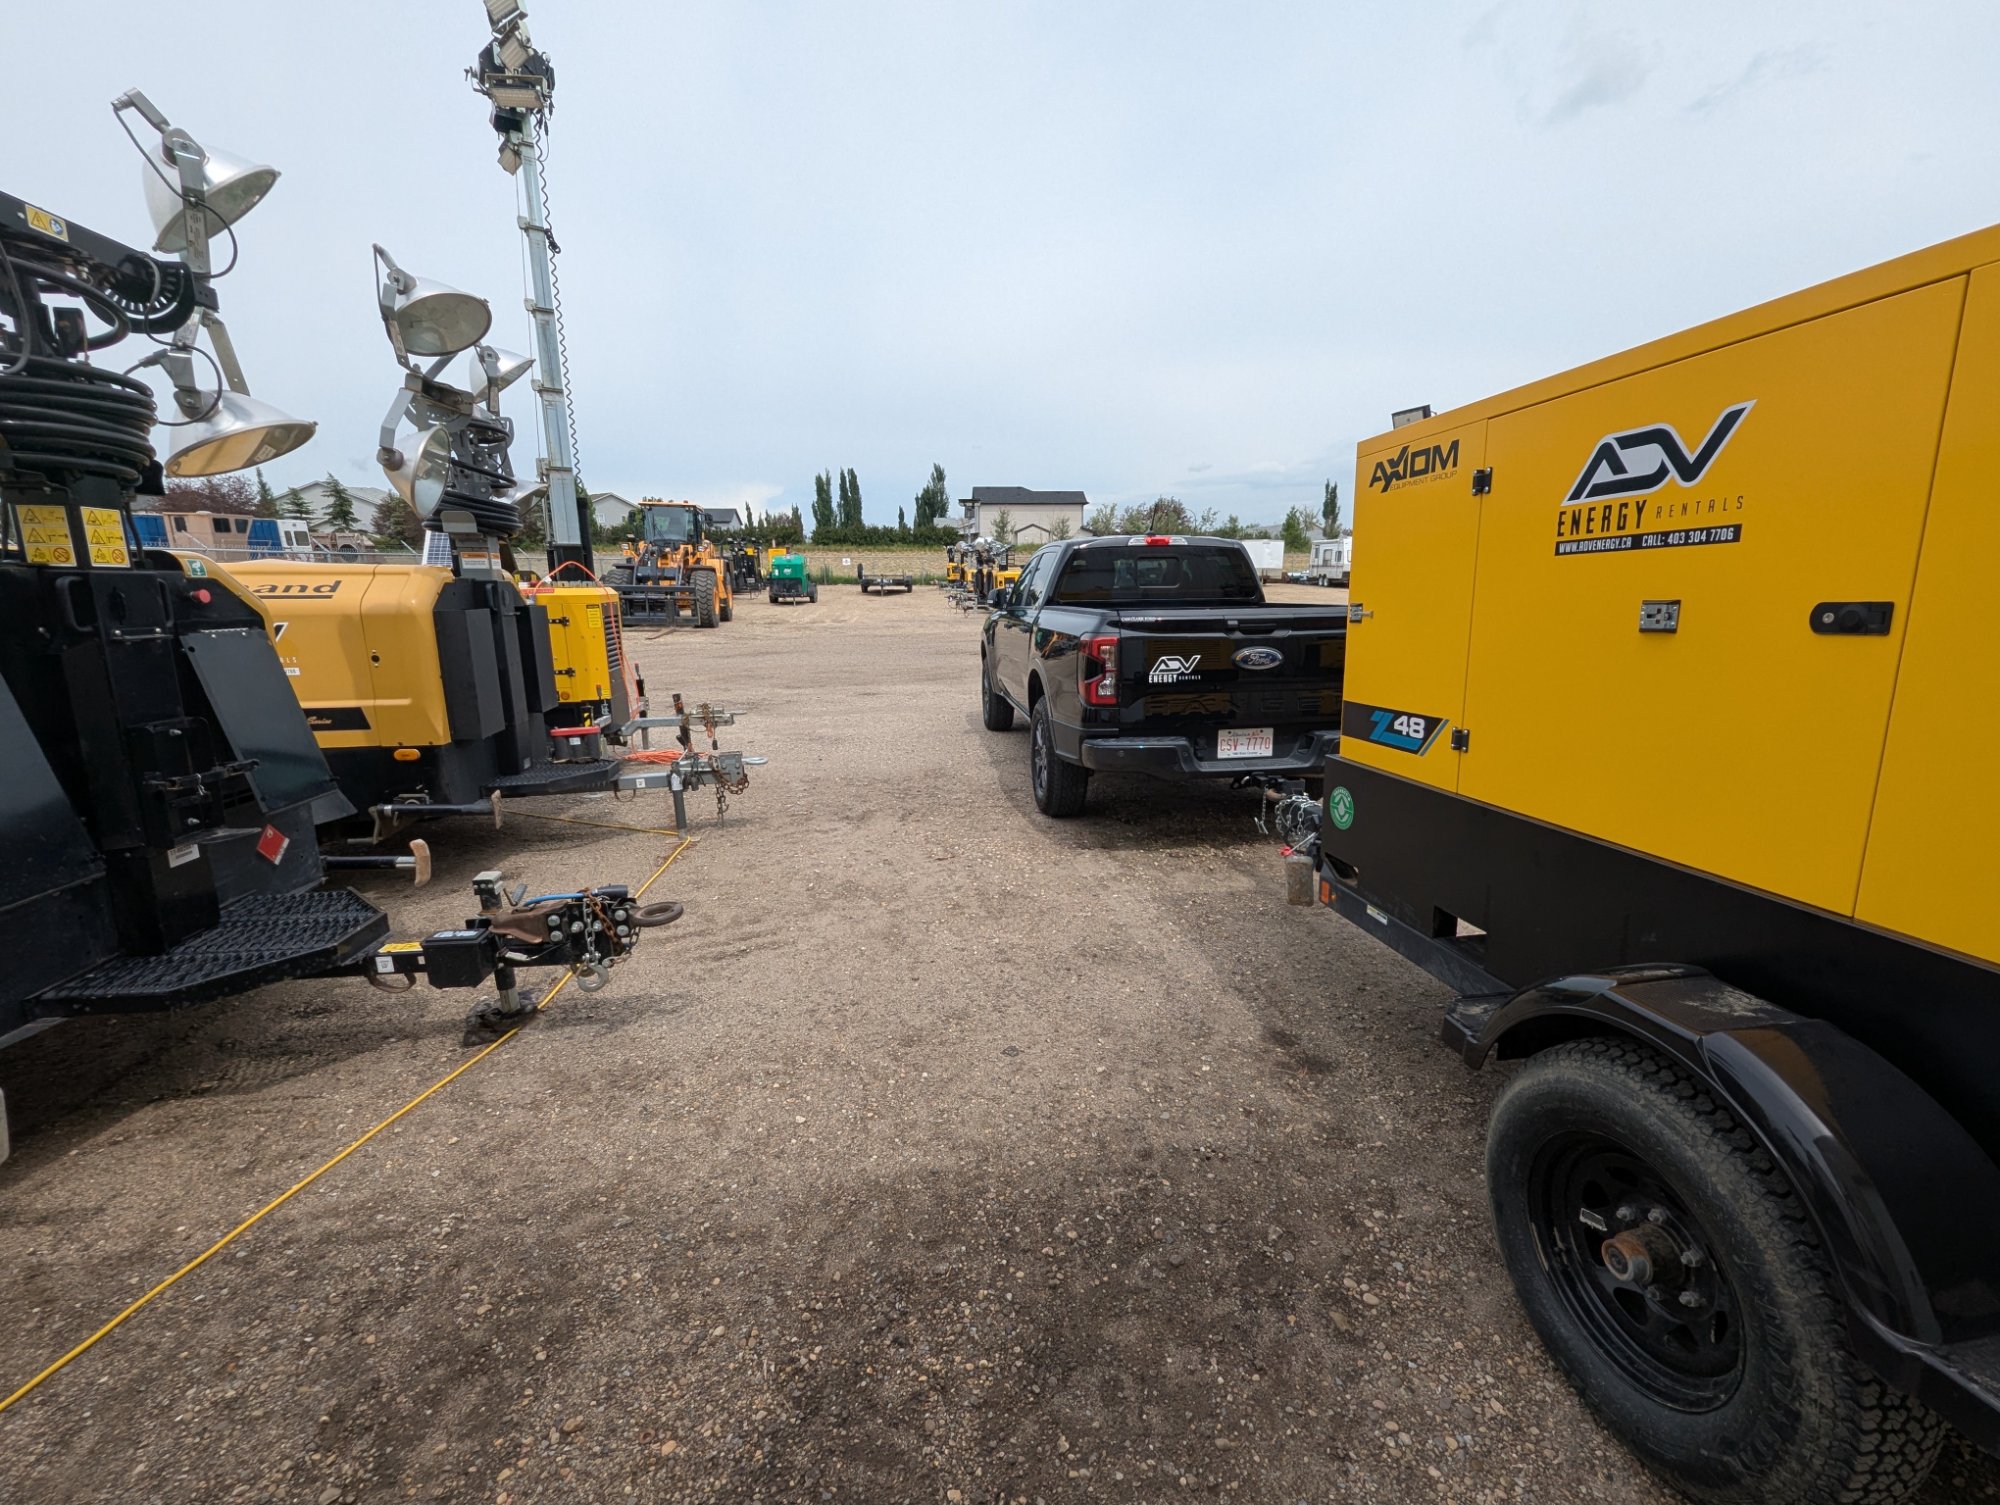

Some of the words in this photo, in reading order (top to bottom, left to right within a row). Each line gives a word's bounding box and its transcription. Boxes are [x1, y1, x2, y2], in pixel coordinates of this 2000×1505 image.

[1560, 399, 1757, 506] ADV
[1368, 438, 1460, 493] AXIOM
[1390, 478, 1429, 492] EQUIPMENT
[1430, 470, 1457, 483] GROUP
[1557, 499, 1648, 537] ENERGY
[1655, 495, 1744, 519] RENTALS
[1558, 536, 1632, 554] WWW.ADVENERGY.CA
[1641, 534, 1665, 547] CALL:
[1667, 532, 1685, 545] 403
[1688, 530, 1707, 543] 304
[1710, 527, 1734, 541] 7706
[247, 580, 342, 594] and
[1149, 674, 1177, 684] ENERGY
[1220, 737, 1271, 751] CSV-7770
